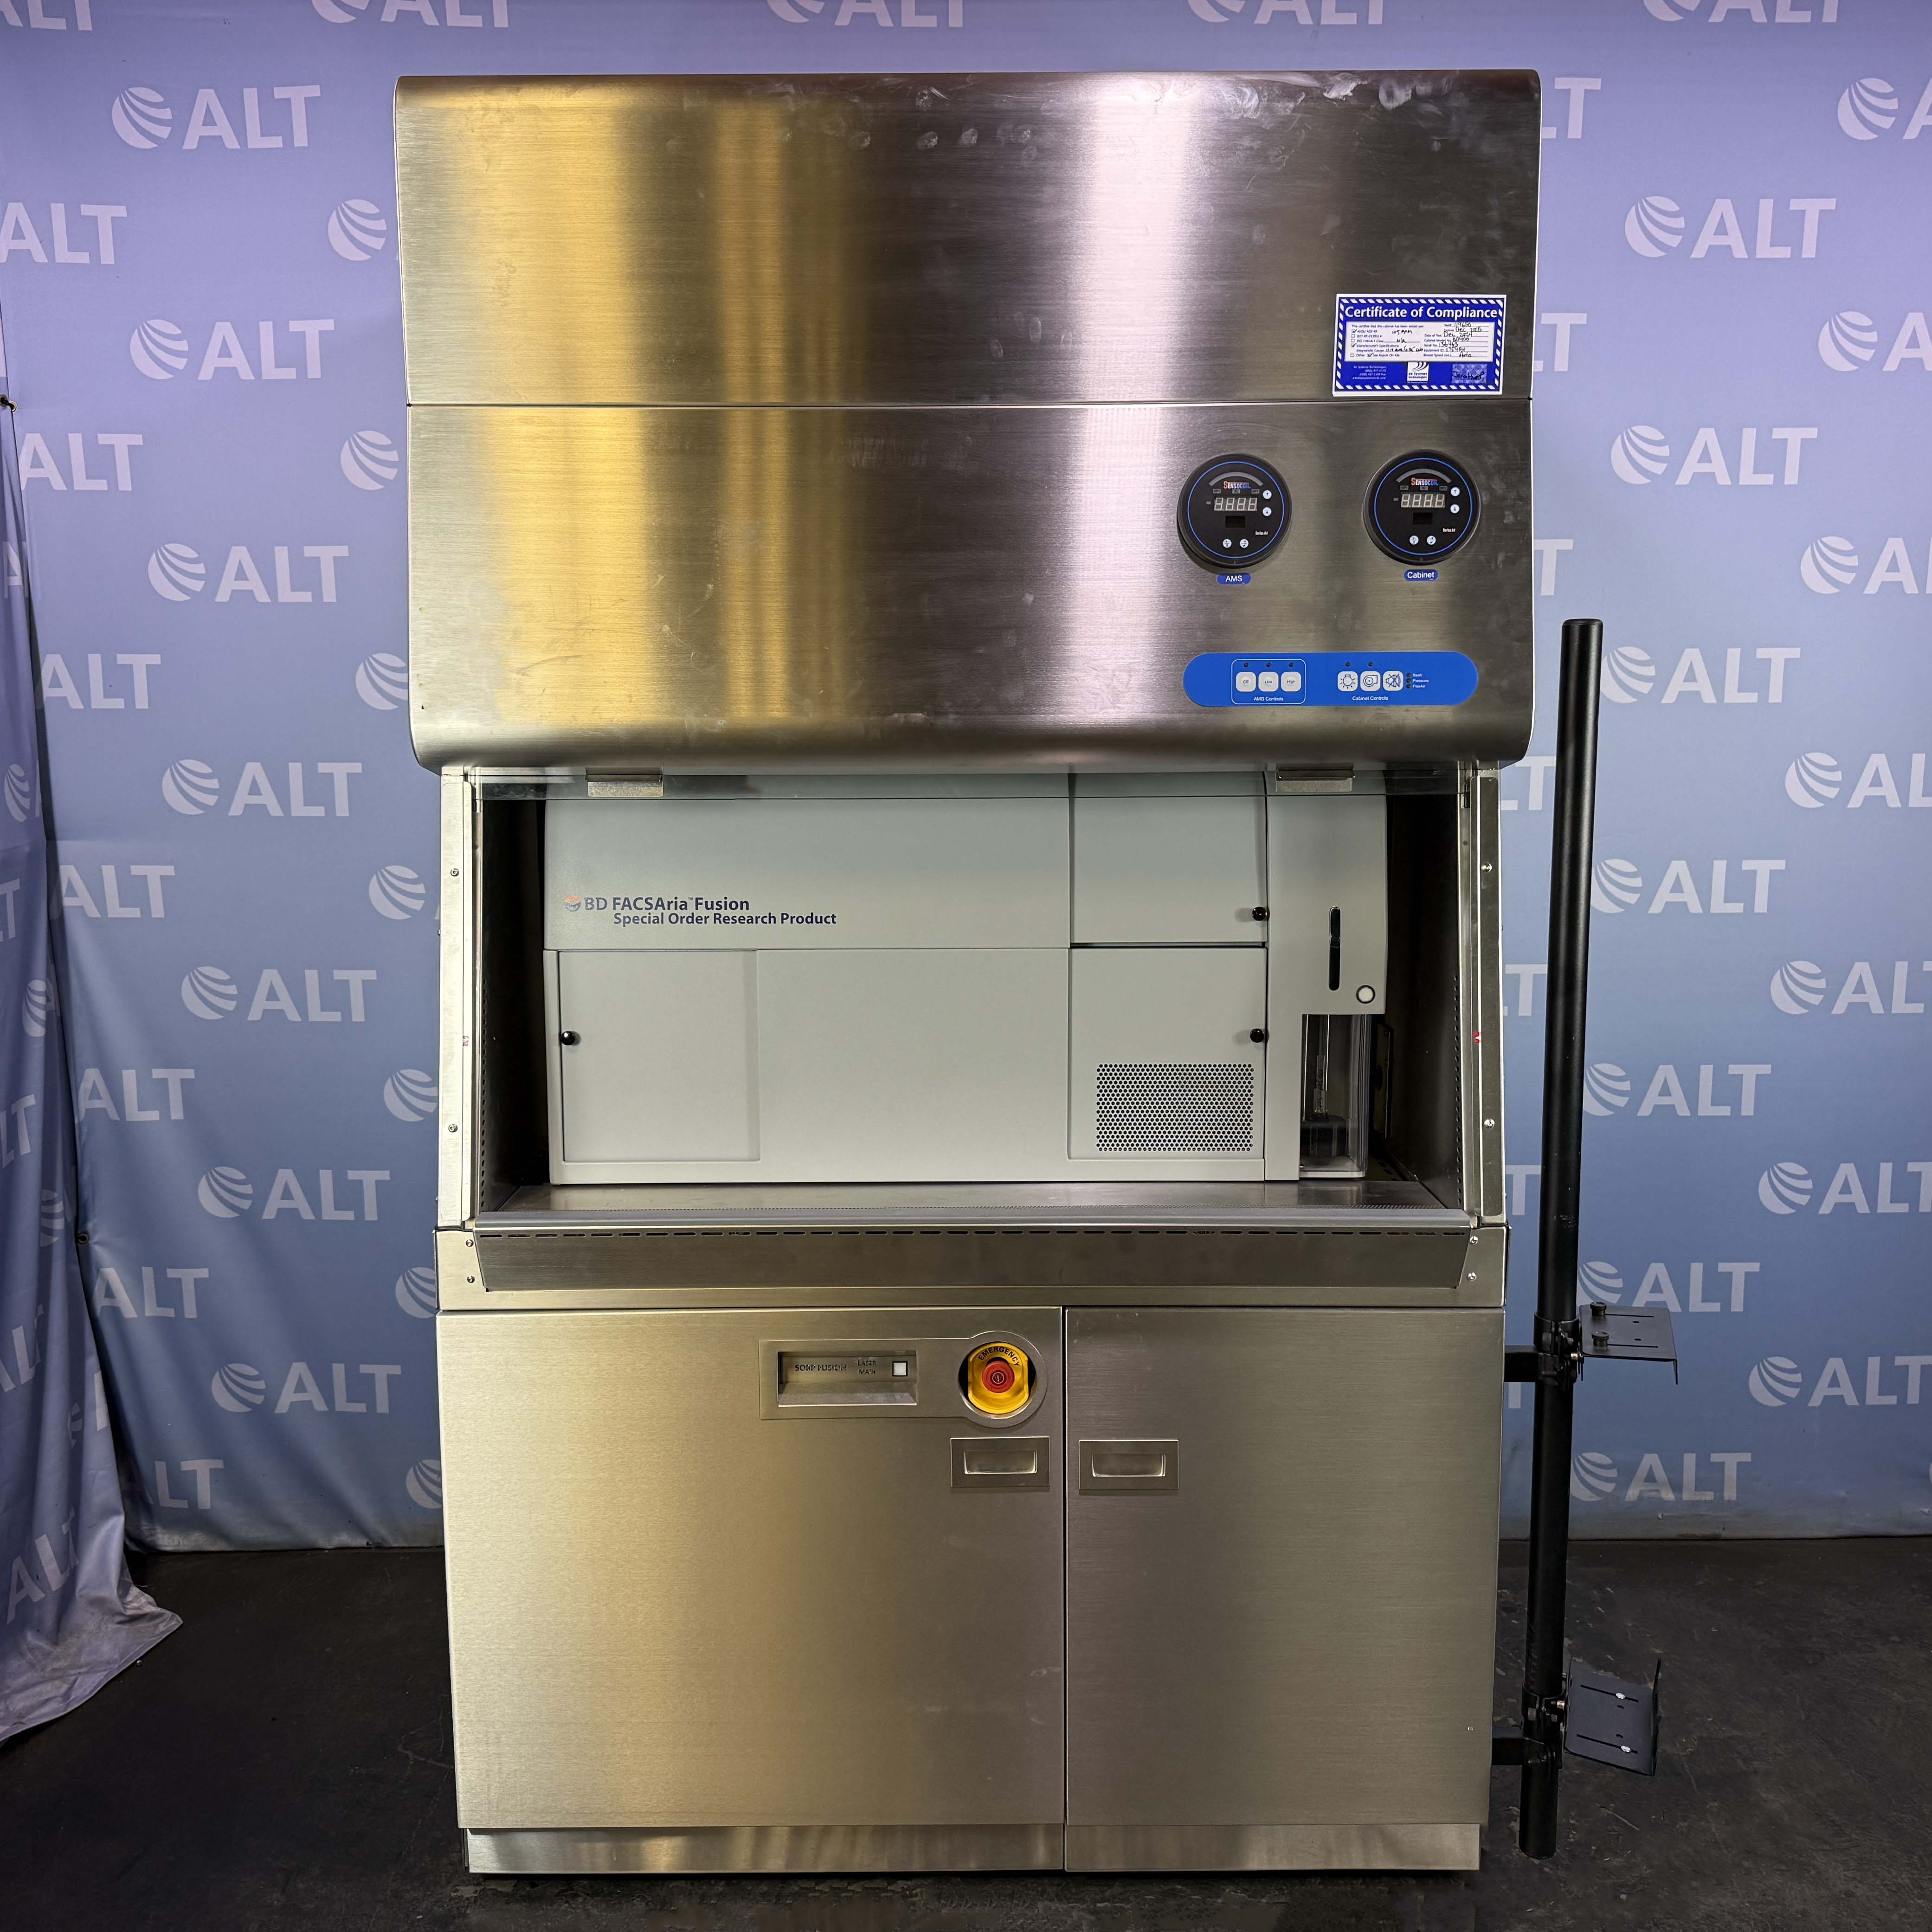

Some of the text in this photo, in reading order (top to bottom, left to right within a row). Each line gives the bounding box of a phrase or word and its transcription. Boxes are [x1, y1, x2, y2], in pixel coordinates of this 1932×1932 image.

[182, 85, 321, 149] ALT
[0, 203, 127, 264] ALT
[1690, 198, 1836, 258] ALT
[1345, 306, 1497, 321] Certificate of Compliance
[198, 319, 335, 380] ALT
[20, 433, 143, 491] ALT
[1674, 427, 1818, 485] ALT
[215, 546, 349, 603] ALT
[37, 654, 161, 709] ALT
[1660, 648, 1801, 704] ALT
[228, 762, 362, 817] ALT
[1847, 753, 1932, 808] AL
[49, 864, 175, 919] ALT
[584, 897, 607, 910] BD
[695, 897, 750, 910] Fusion
[1648, 859, 1786, 914] ALT
[613, 913, 837, 927] Special Order Research Product
[247, 969, 377, 1022] ALT
[1831, 961, 1932, 1014] AL
[76, 1068, 195, 1122] ALT
[1636, 1064, 1771, 1117] ALT
[0, 1094, 36, 1168] LT
[262, 1169, 390, 1221] ALT
[95, 1266, 209, 1319] ALT
[1631, 1262, 1760, 1313] ALT
[978, 1346, 1020, 1366] EMERGENCY
[1808, 1355, 1932, 1406] ALT
[274, 1362, 401, 1414] ALT
[146, 1459, 224, 1509] LT
[1624, 1452, 1752, 1501] ALT
